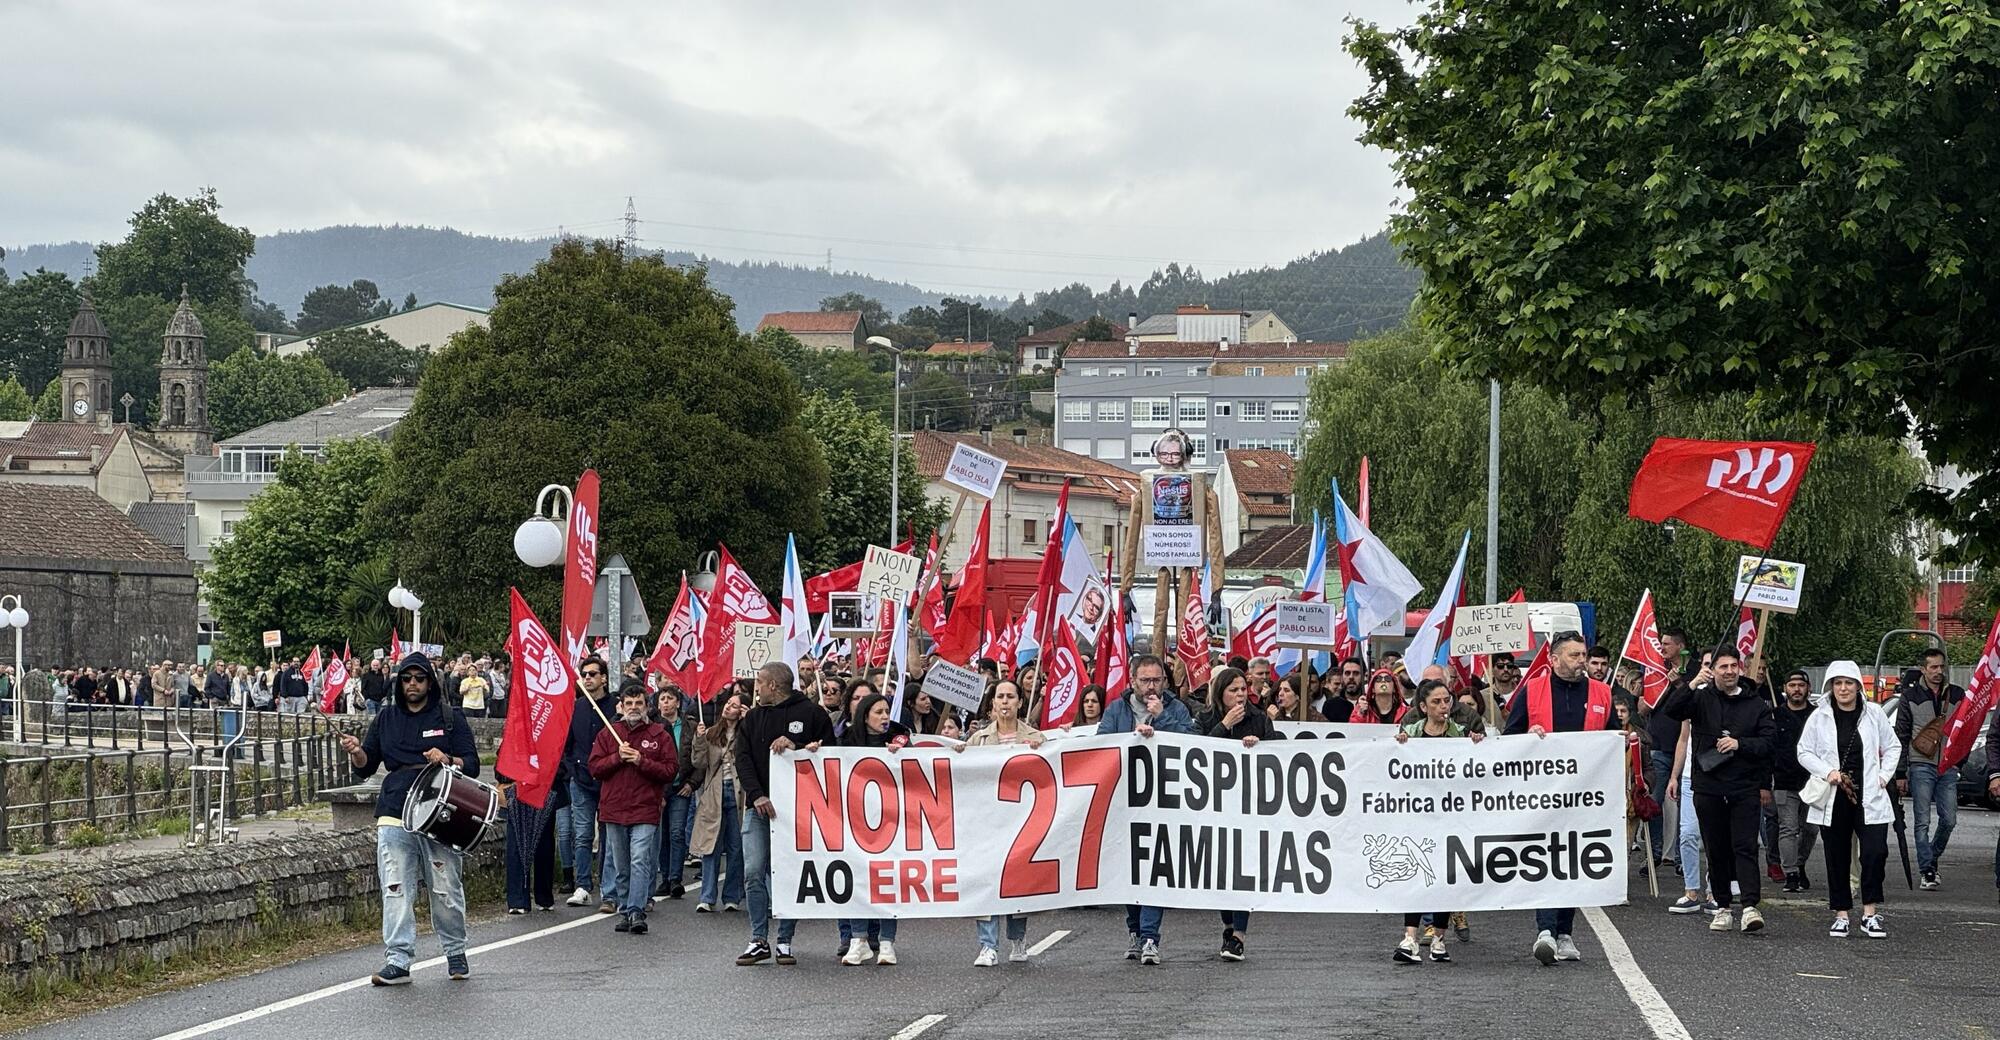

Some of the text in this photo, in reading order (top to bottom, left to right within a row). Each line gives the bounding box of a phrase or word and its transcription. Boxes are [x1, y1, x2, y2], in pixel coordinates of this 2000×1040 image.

[960, 449, 973, 458] NON
[951, 464, 989, 486] PABLO ISLA
[880, 572, 901, 586] AO
[1472, 605, 1514, 622] NESTLÉ
[1280, 624, 1325, 634] PABLO ISLA
[1455, 622, 1523, 638] QUEN TE VEU
[1486, 634, 1493, 643] E
[751, 648, 766, 663] 27
[1457, 641, 1521, 655] QUEN TE VE
[940, 663, 980, 683] NON SOMOS
[927, 677, 980, 703] SOMOS FAMILIAS
[1388, 757, 1578, 782] Comité de empresa
[1128, 744, 1348, 818] DESPIDOS
[794, 756, 956, 854] NON
[1362, 790, 1606, 814] Fábrica de Pontecesures
[997, 746, 1122, 899] 27
[1130, 822, 1332, 895] FAMILIAS
[1446, 828, 1614, 885] Nestlé
[796, 858, 960, 904] AO ERE
